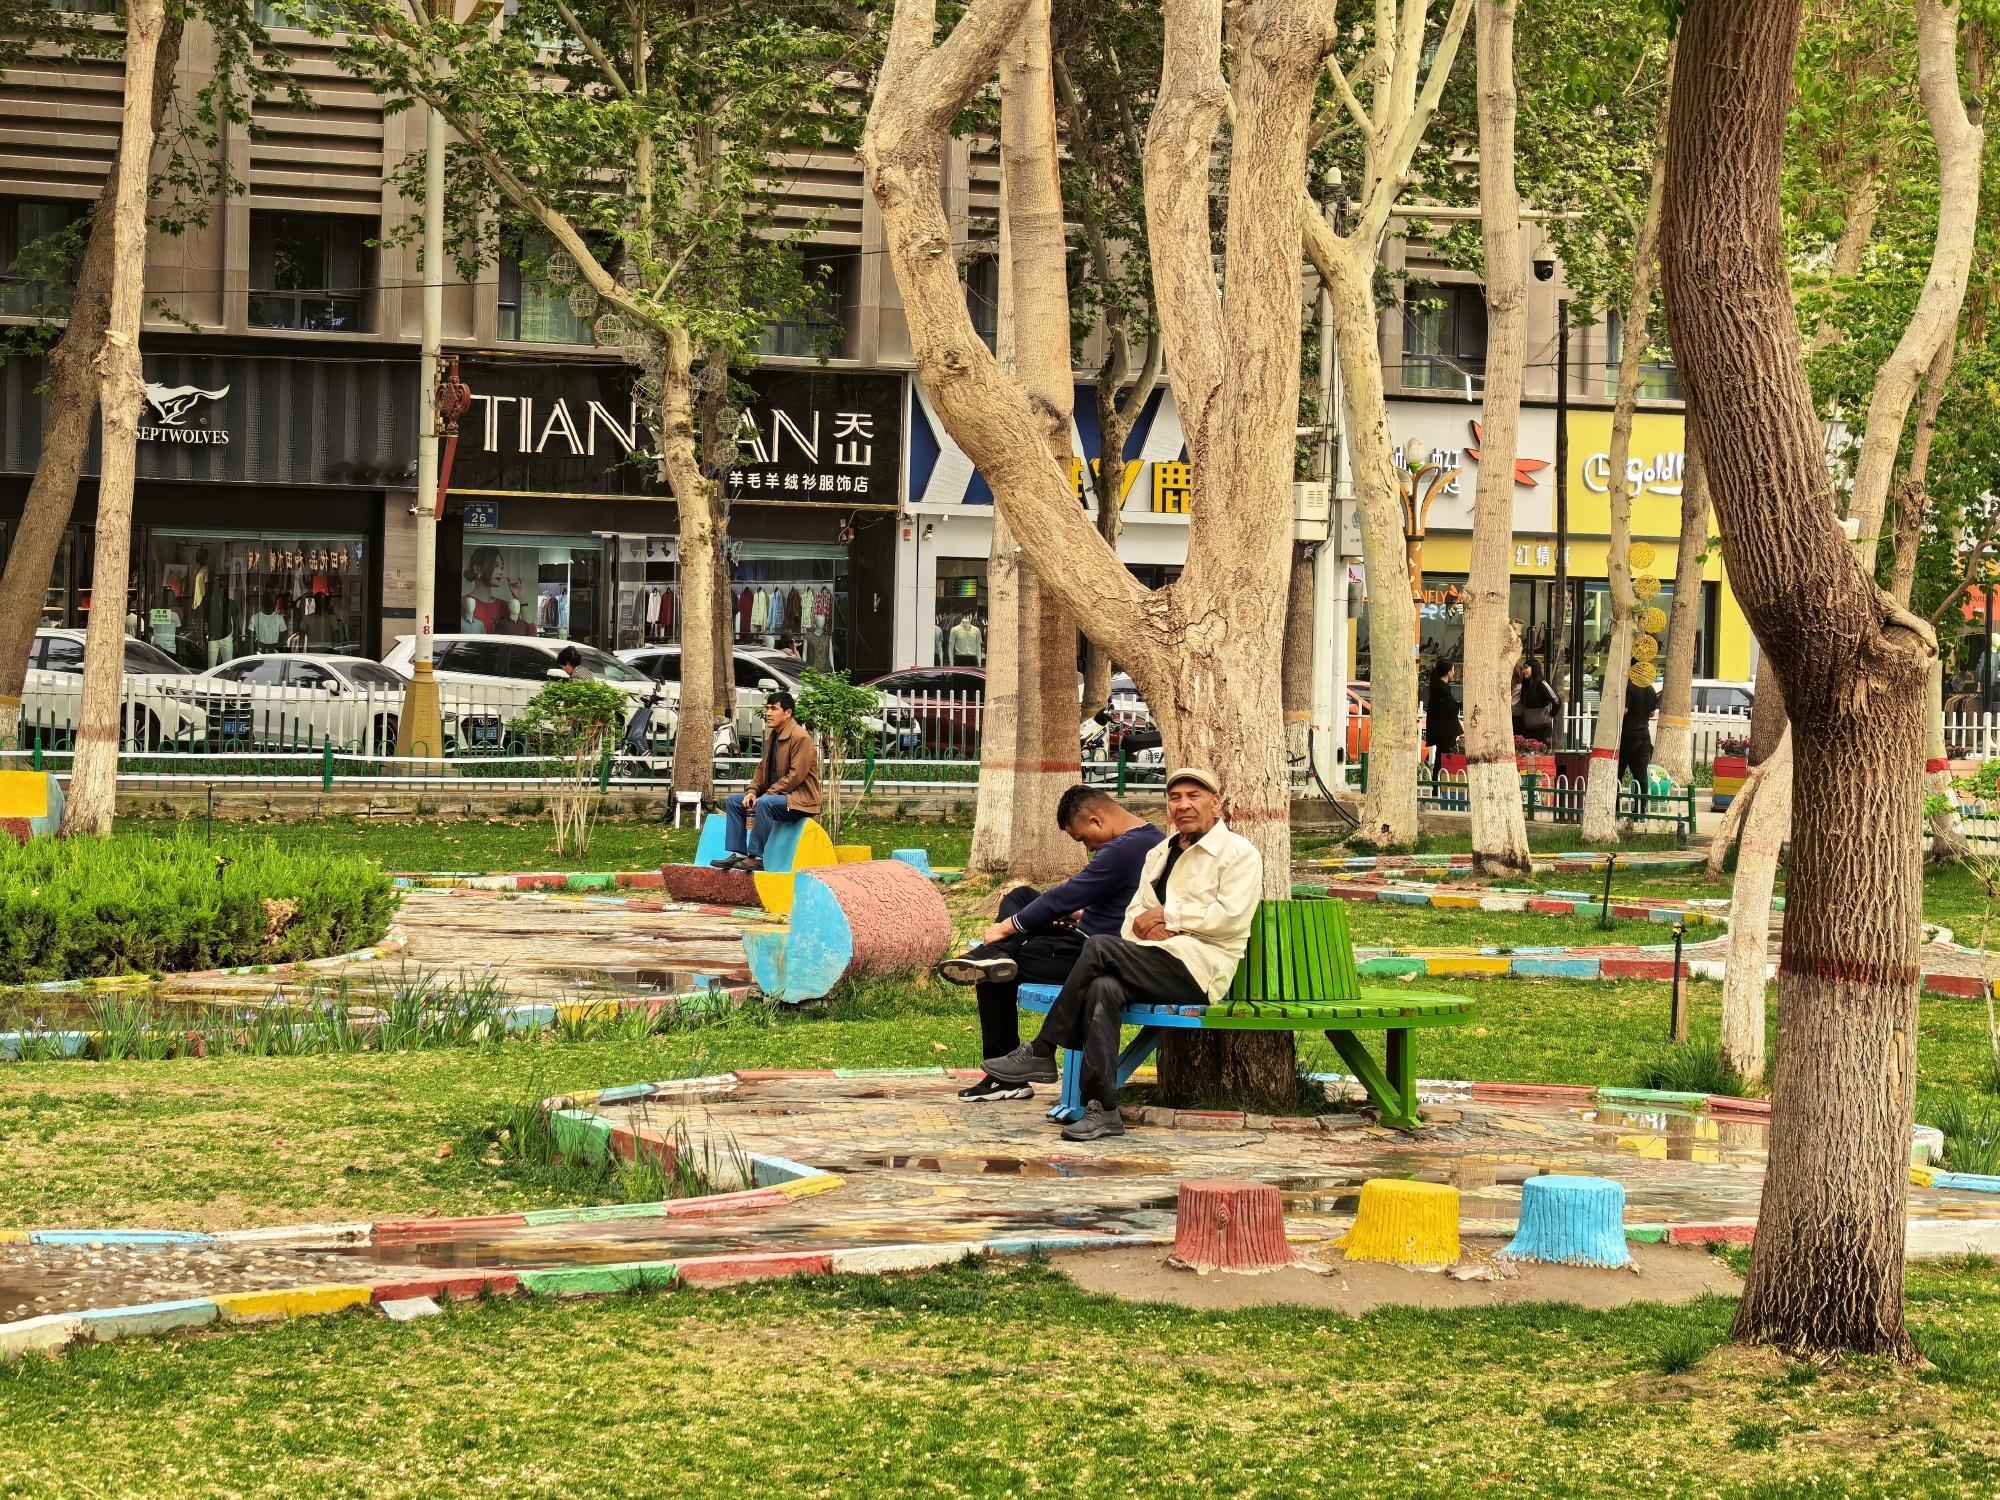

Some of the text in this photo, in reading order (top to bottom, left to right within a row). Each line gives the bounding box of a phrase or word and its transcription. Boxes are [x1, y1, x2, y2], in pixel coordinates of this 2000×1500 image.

[833, 412, 875, 466] 天山
[729, 470, 869, 493] 羊毛羊绒衫服饰店
[471, 513, 486, 523] 26
